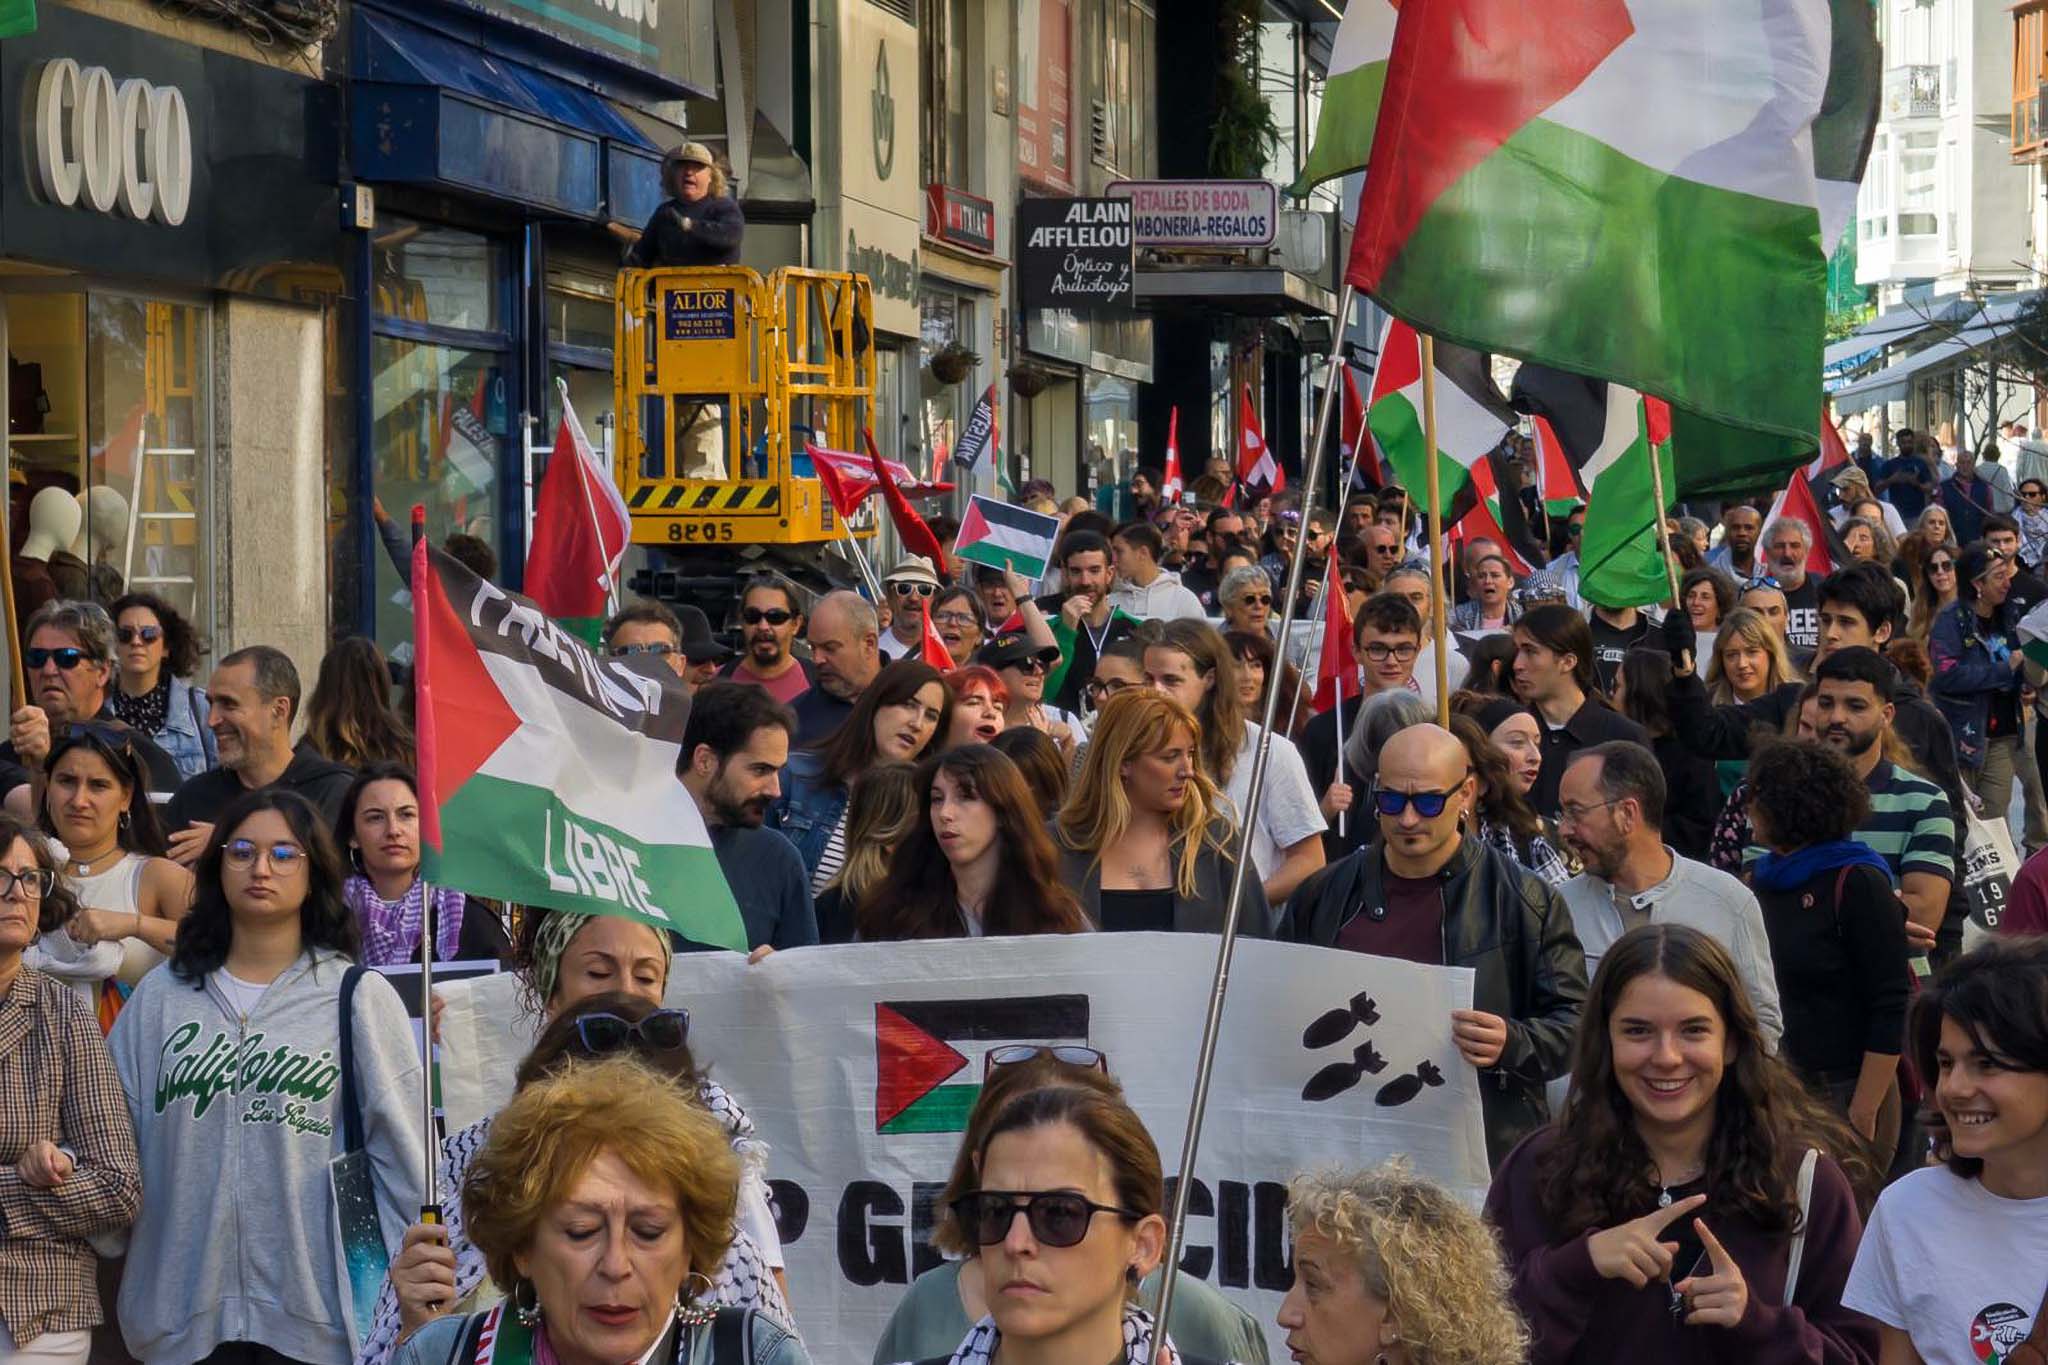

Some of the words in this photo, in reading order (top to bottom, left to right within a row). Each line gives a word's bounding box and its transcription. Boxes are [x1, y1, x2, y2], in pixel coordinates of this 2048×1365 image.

[36, 58, 192, 226] COCO
[1065, 203, 1130, 223] ALAIN
[1132, 190, 1189, 211] DETALLES
[1192, 190, 1209, 211] DE
[1212, 190, 1250, 212] BODA
[1028, 227, 1130, 247] AFFLELOU
[1120, 264, 1130, 281] y
[673, 290, 727, 310] ALTOR
[1786, 608, 1818, 634] EE
[544, 808, 670, 921] LIBRE
[155, 1021, 341, 1119] California
[243, 1099, 275, 1124] Los
[278, 1102, 334, 1137] Angeles
